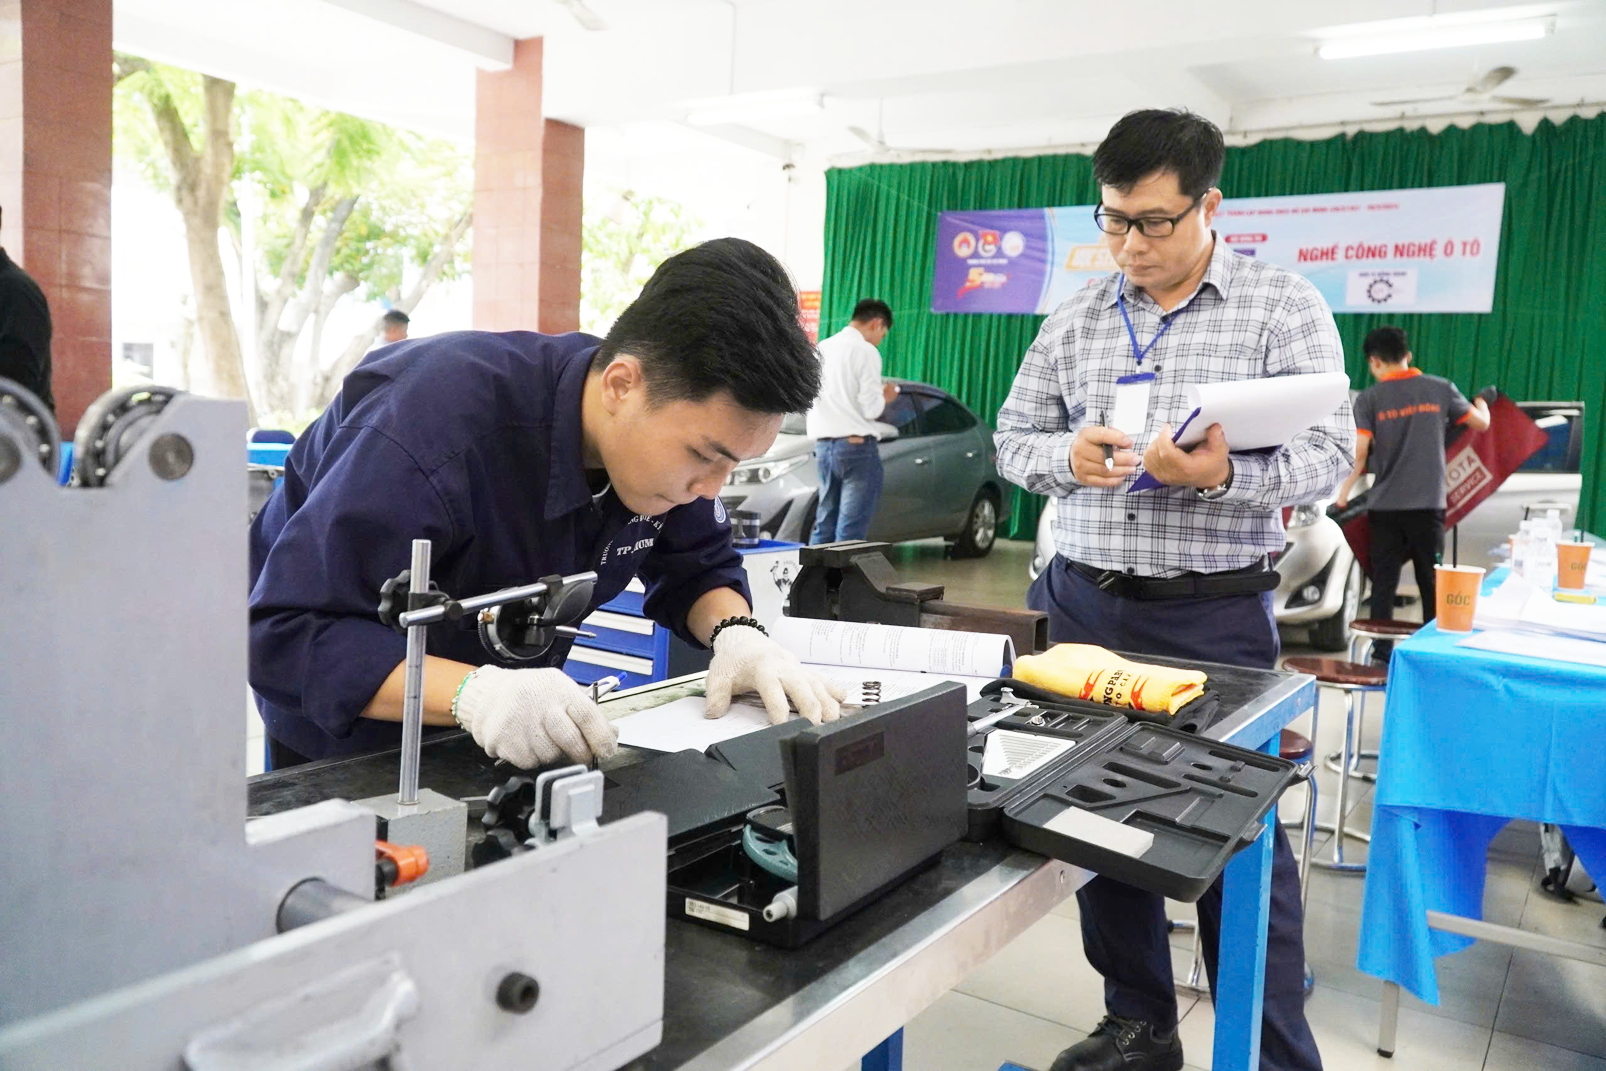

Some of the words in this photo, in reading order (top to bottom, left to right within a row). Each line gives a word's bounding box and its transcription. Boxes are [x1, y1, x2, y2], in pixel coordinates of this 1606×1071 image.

[1344, 240, 1388, 260] CÔNG
[1443, 237, 1455, 257] Ô
[1461, 237, 1481, 257] TÔ
[1446, 590, 1470, 606] GÓC
